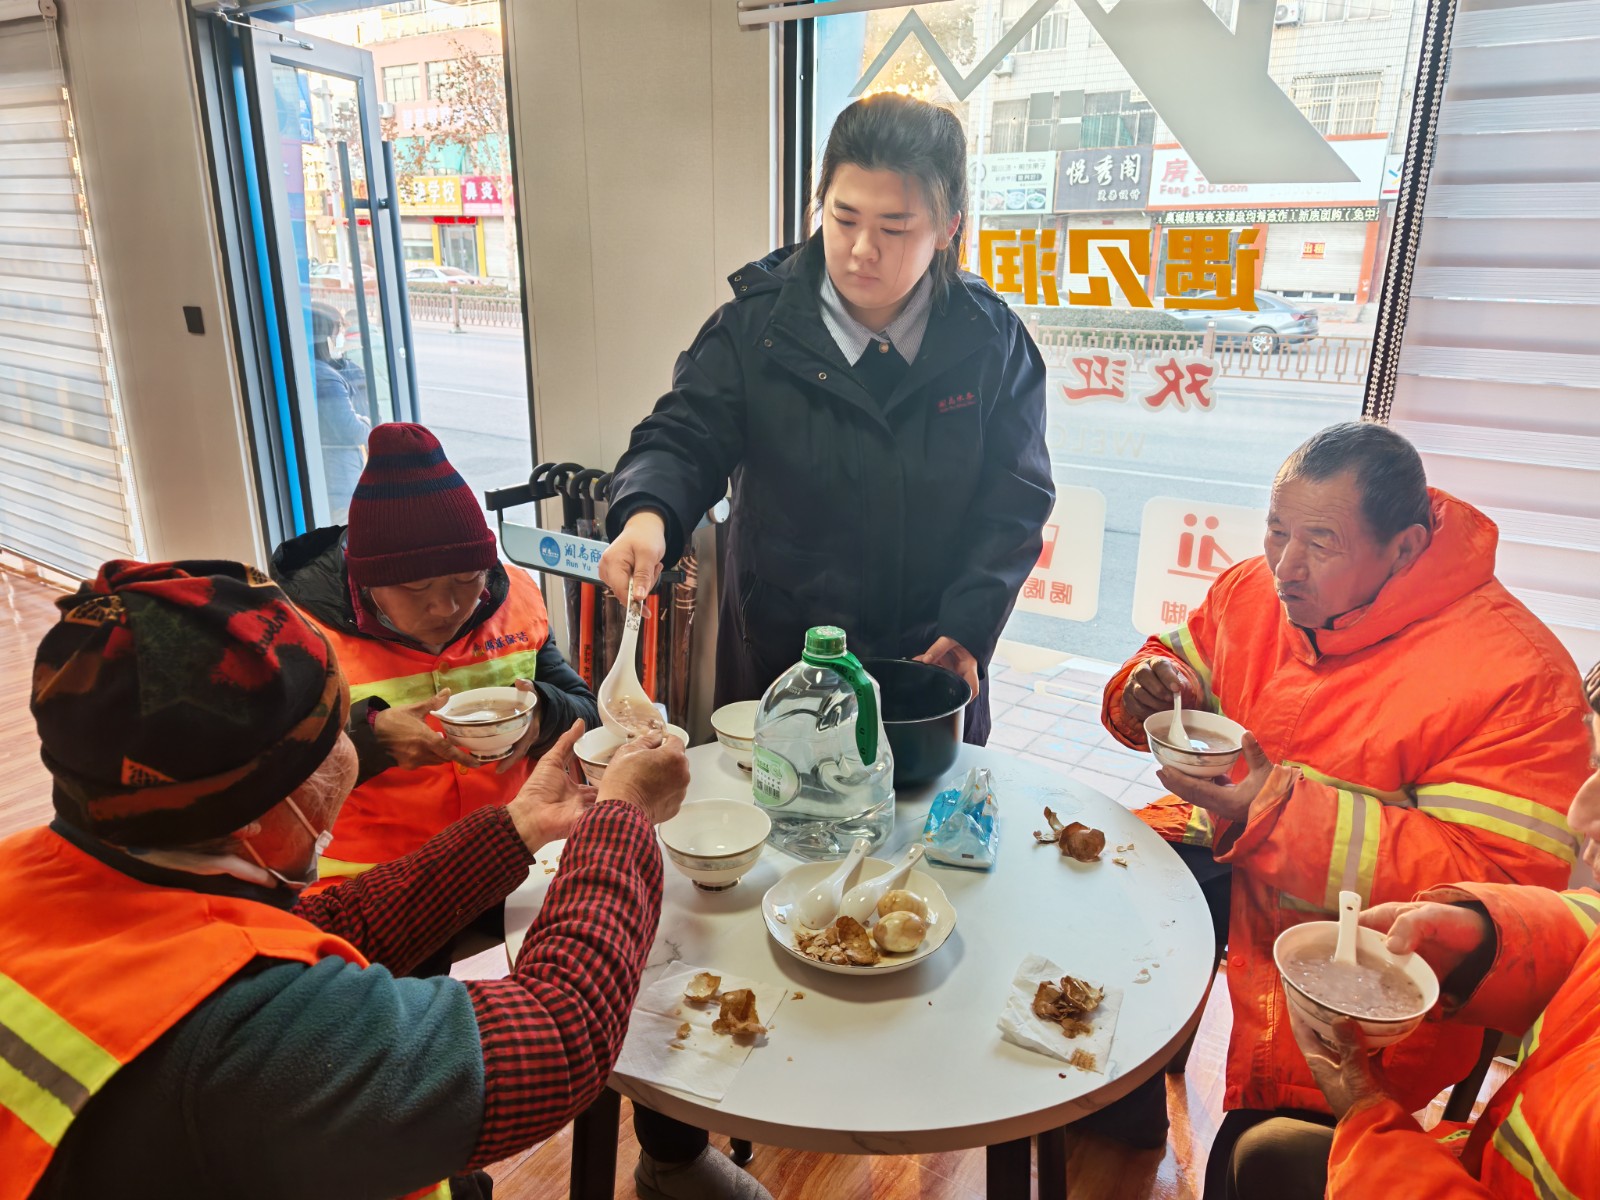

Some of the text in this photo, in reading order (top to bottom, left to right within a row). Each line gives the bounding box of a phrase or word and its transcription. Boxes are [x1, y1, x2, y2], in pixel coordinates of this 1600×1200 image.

[1066, 153, 1142, 186] 悦秀阁
[1160, 158, 1205, 183] 房
[1304, 243, 1325, 255] 出租
[565, 558, 592, 572] Run Yu
